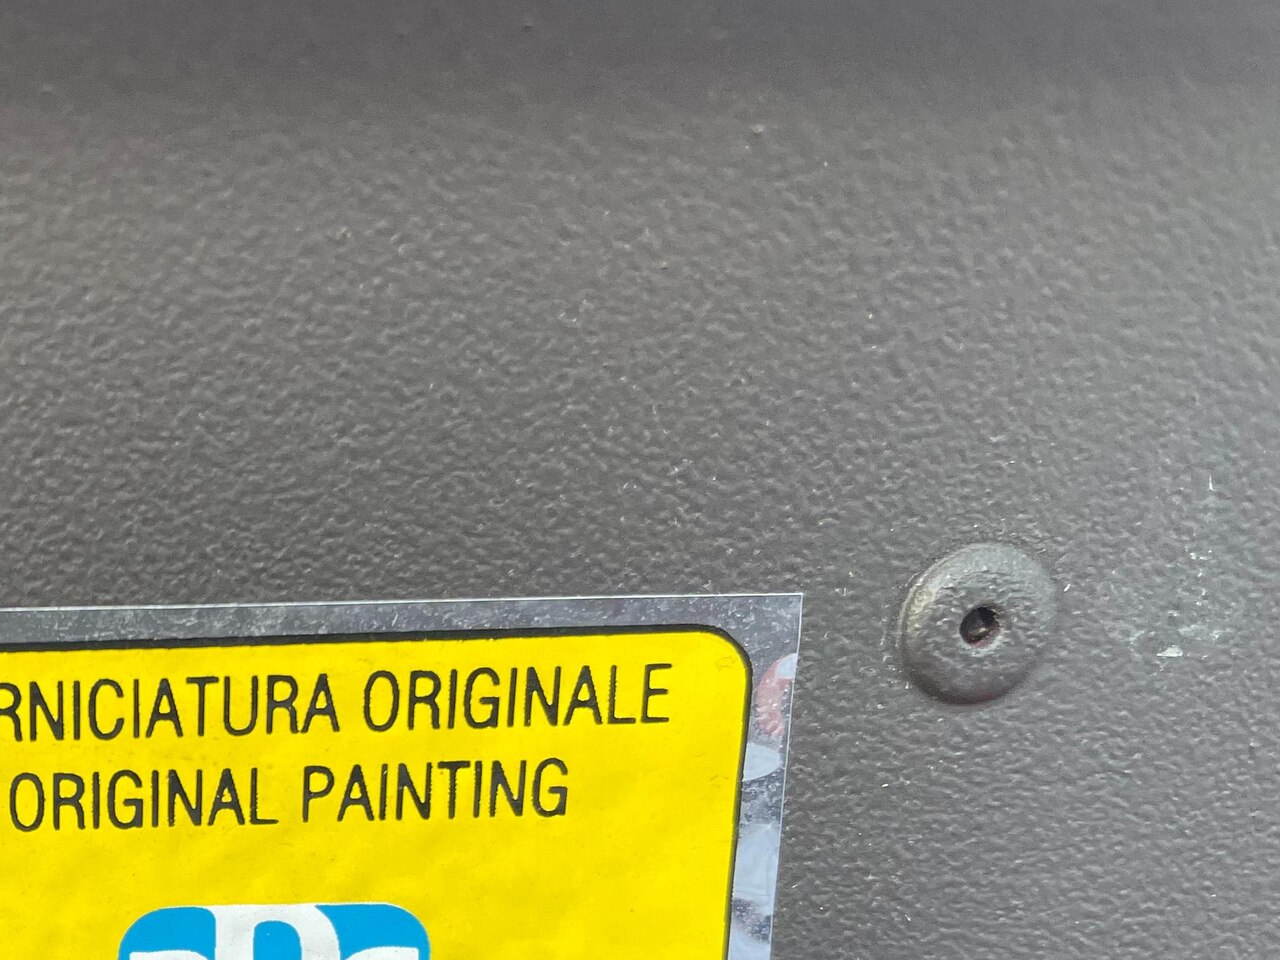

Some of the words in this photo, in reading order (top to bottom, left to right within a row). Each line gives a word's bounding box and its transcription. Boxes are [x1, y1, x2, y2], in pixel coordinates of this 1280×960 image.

[362, 663, 673, 733] ORIGINALE
[9, 767, 279, 832] ORIGINAL
[302, 757, 569, 823] PAINTING
